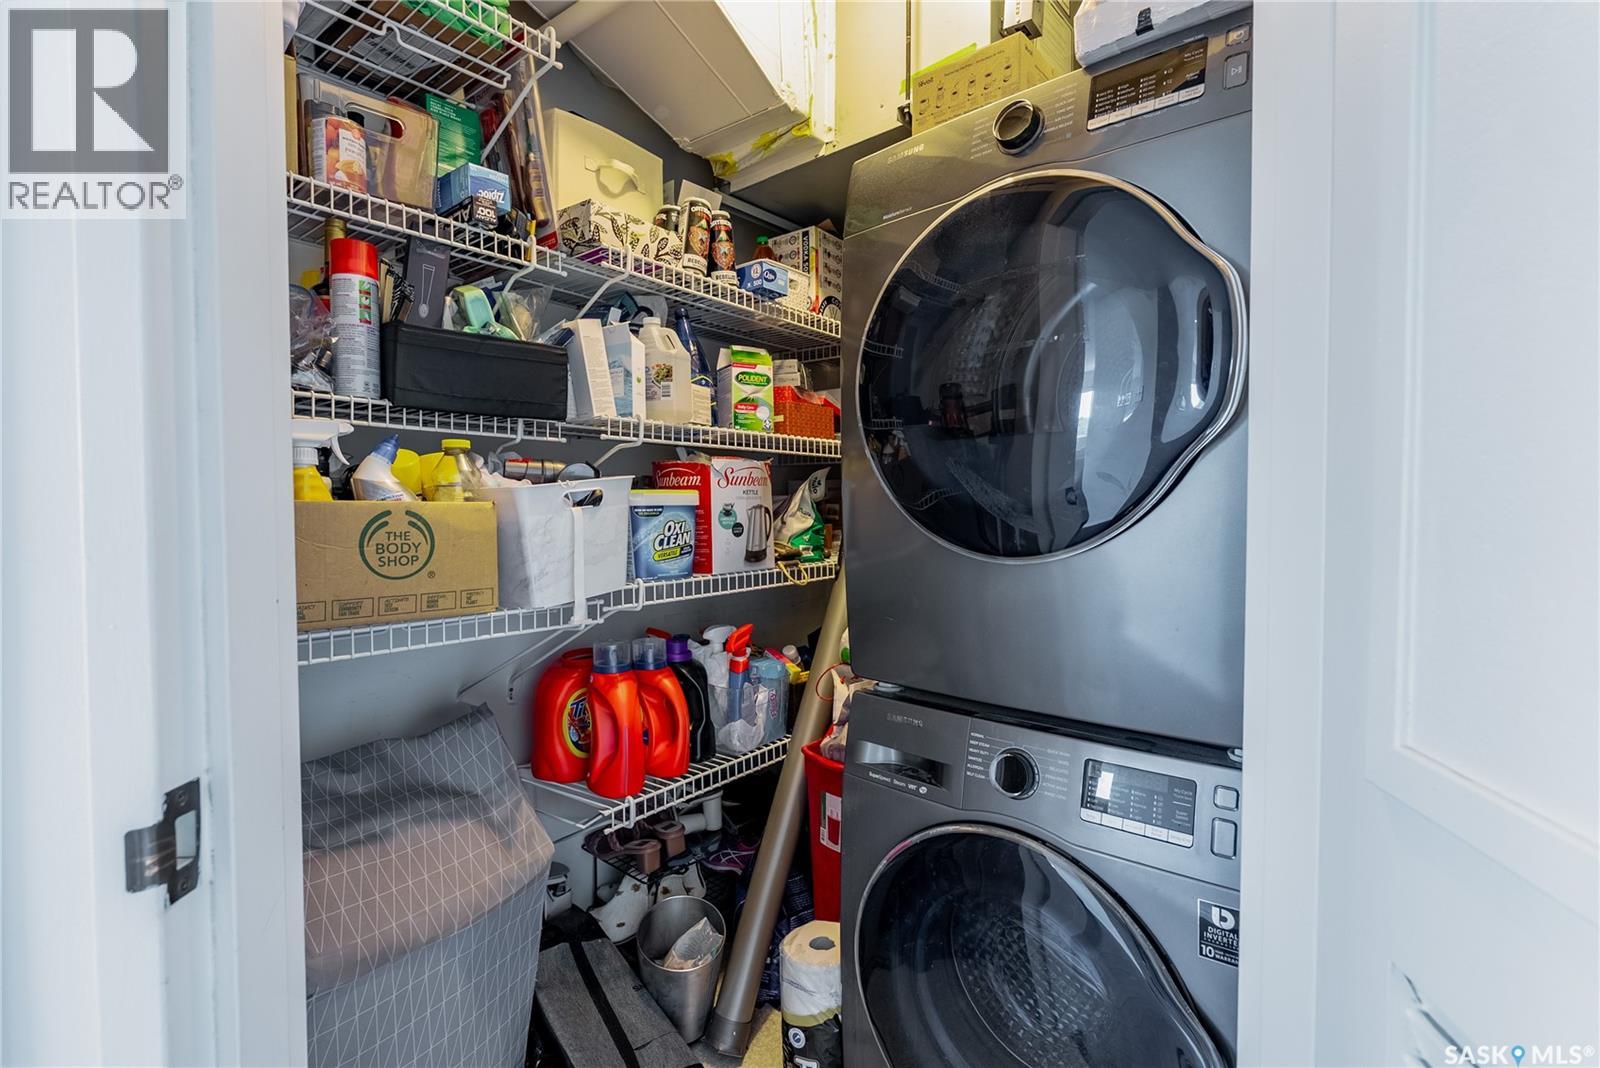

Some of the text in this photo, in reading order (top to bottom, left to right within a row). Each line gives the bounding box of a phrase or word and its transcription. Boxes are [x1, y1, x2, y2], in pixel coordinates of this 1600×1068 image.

[738, 373, 768, 383] POLIDENT
[655, 469, 702, 488] Sunbeam
[717, 466, 768, 489] Sunbeam
[663, 519, 686, 537] OXI
[384, 531, 411, 542] THE
[654, 531, 691, 552] CLEAN
[375, 542, 422, 555] BODY
[378, 555, 420, 568] SHOP
[570, 695, 589, 719] Ti
[1203, 931, 1239, 947] INVERTE
[1207, 926, 1239, 940] DIGITAL
[1200, 944, 1215, 958] 10
